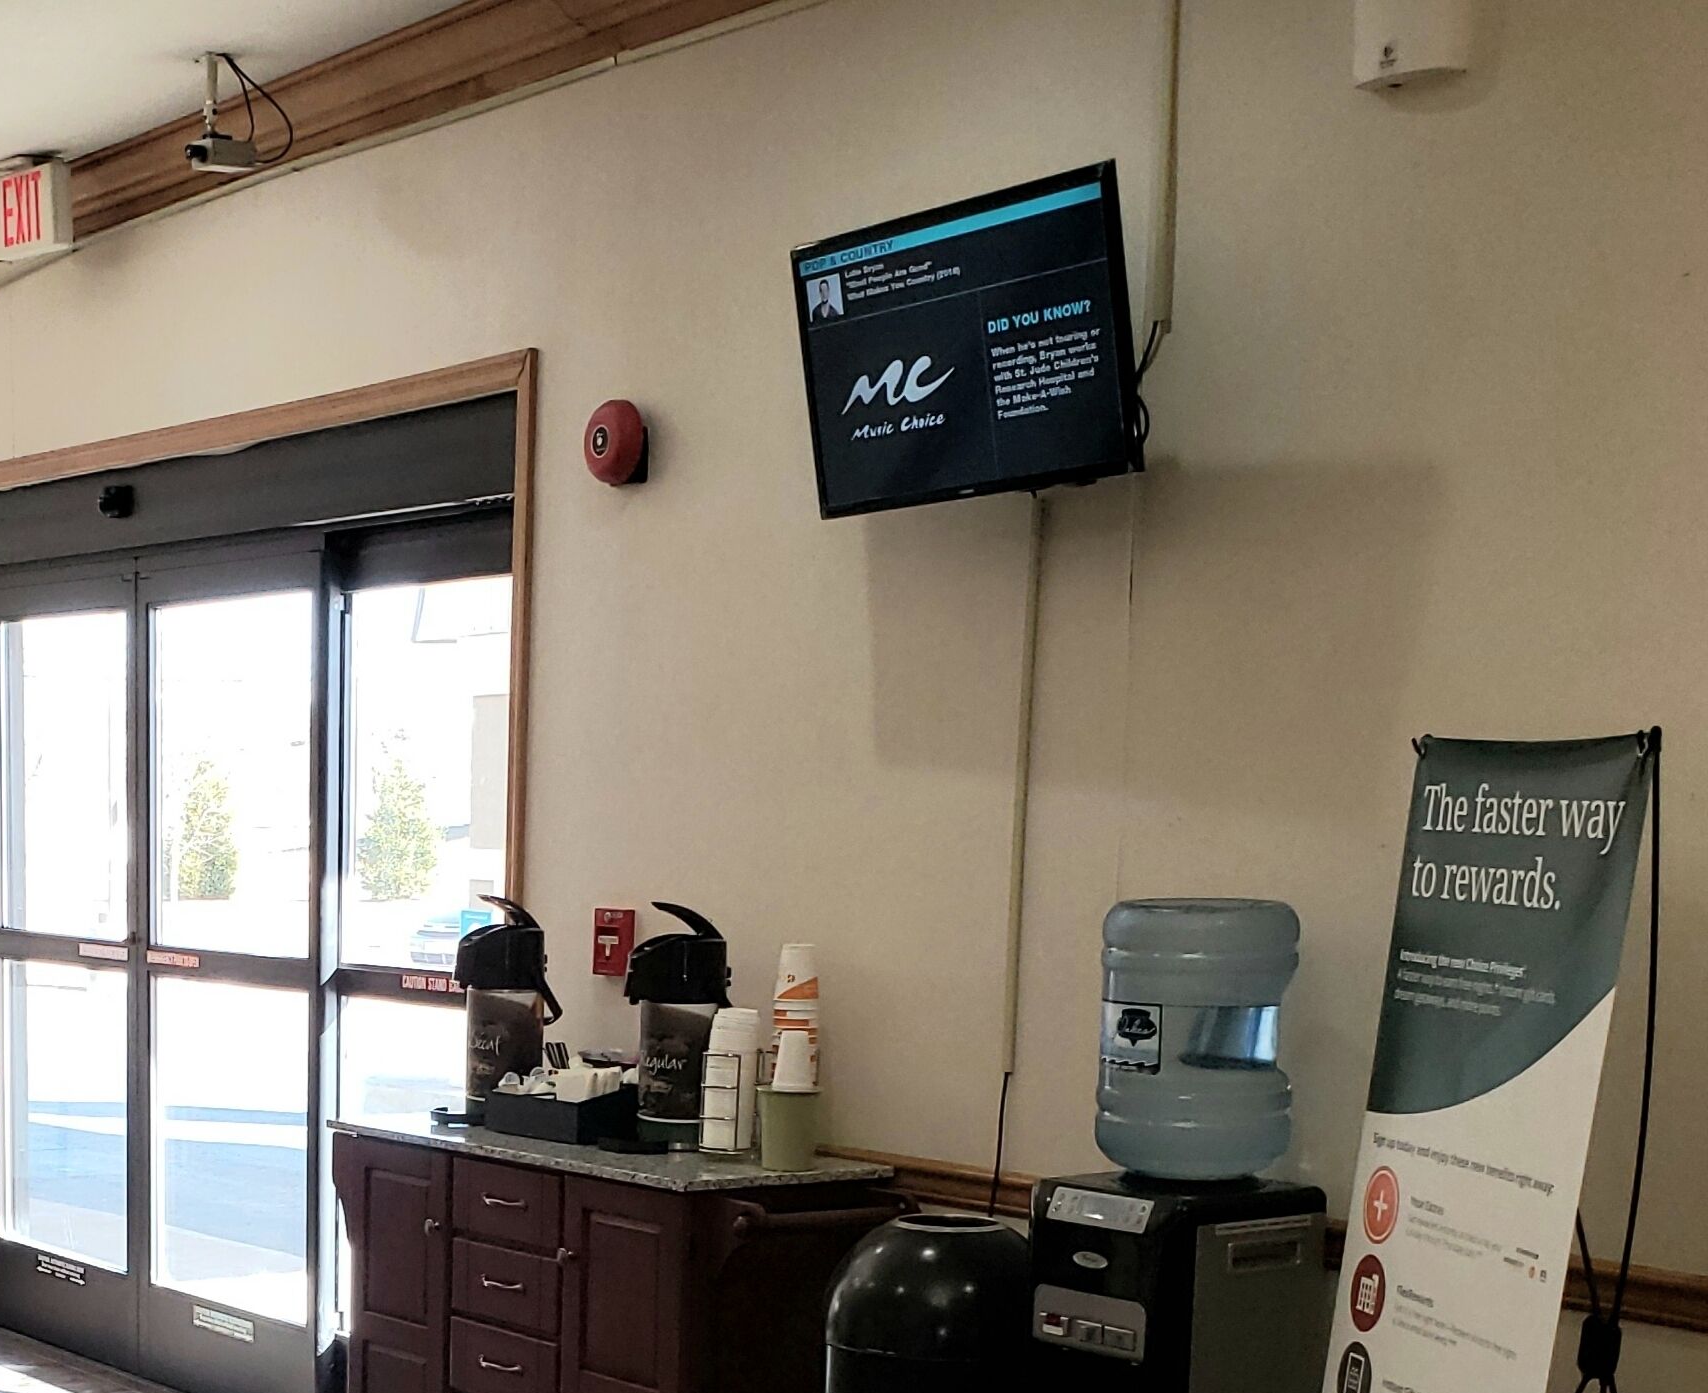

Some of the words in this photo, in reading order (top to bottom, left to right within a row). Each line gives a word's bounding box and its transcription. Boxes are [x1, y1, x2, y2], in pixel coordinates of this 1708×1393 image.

[1, 170, 42, 248] EXIT
[804, 260, 827, 273] POP
[841, 240, 894, 263] COUNTRY
[987, 318, 1010, 334] DID
[1012, 310, 1039, 328] YOU
[1043, 300, 1091, 322] KNOW?
[991, 346, 1016, 357] When
[1038, 337, 1054, 347] not
[1055, 331, 1088, 343] touring
[1090, 328, 1101, 336] or
[1039, 349, 1066, 360] Bryan
[1068, 342, 1097, 354] works
[993, 371, 1013, 382] with
[1030, 363, 1051, 375] Jude
[1053, 353, 1099, 370] Children's
[995, 379, 1037, 395] Research
[1038, 370, 1075, 386] Hospital
[1078, 366, 1095, 379] and
[841, 355, 955, 415] MC
[996, 396, 1011, 407] the
[851, 421, 894, 440] Music
[900, 413, 945, 432] Choice
[1421, 782, 1468, 833] The
[1472, 782, 1553, 836] faster
[1560, 798, 1626, 855] way
[1411, 855, 1437, 898] to
[1440, 855, 1562, 911] rewards.
